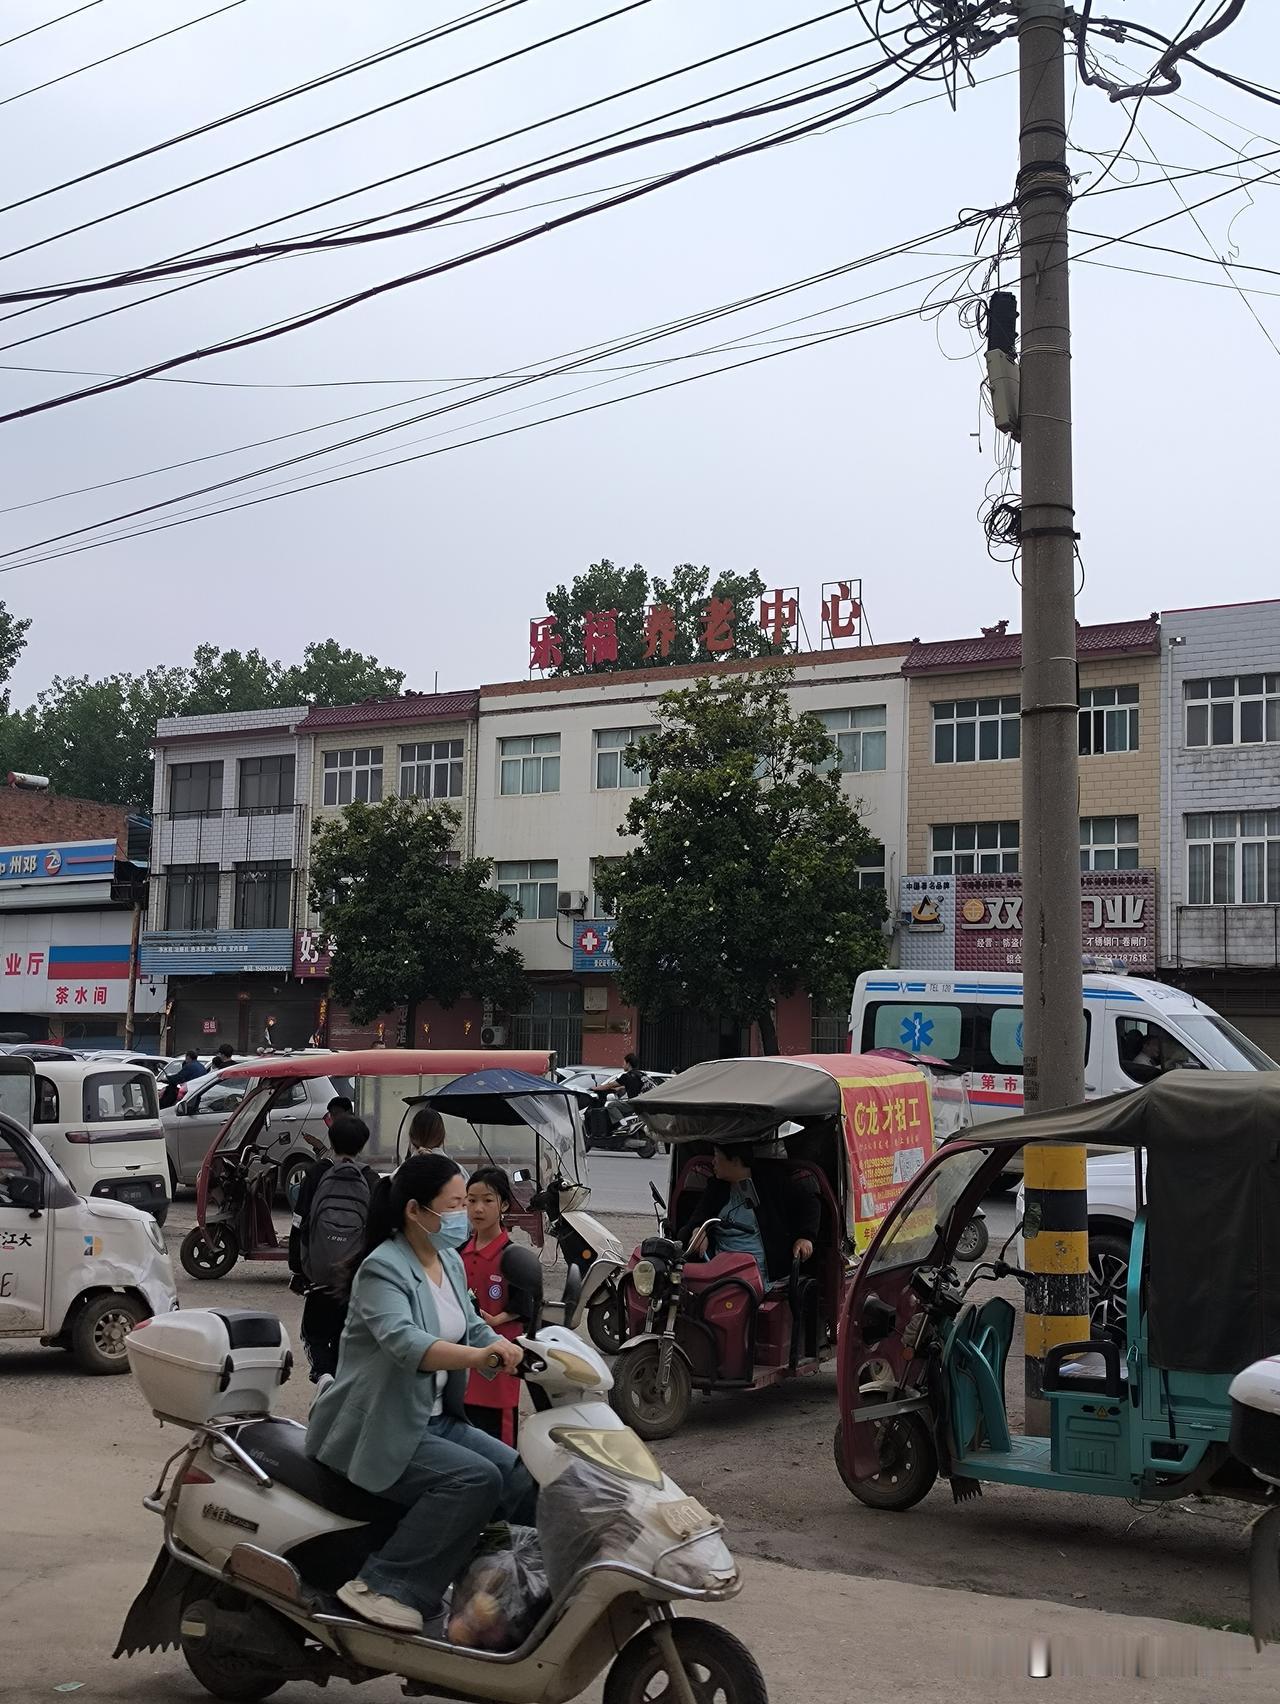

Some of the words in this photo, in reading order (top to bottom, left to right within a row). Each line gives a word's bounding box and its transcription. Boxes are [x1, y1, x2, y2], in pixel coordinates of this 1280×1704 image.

[530, 580, 861, 669] 乐福养老中心
[55, 986, 108, 1005] 茶水间
[929, 983, 939, 993] TEL
[941, 983, 952, 993] 120
[0, 1231, 33, 1248] 江大
